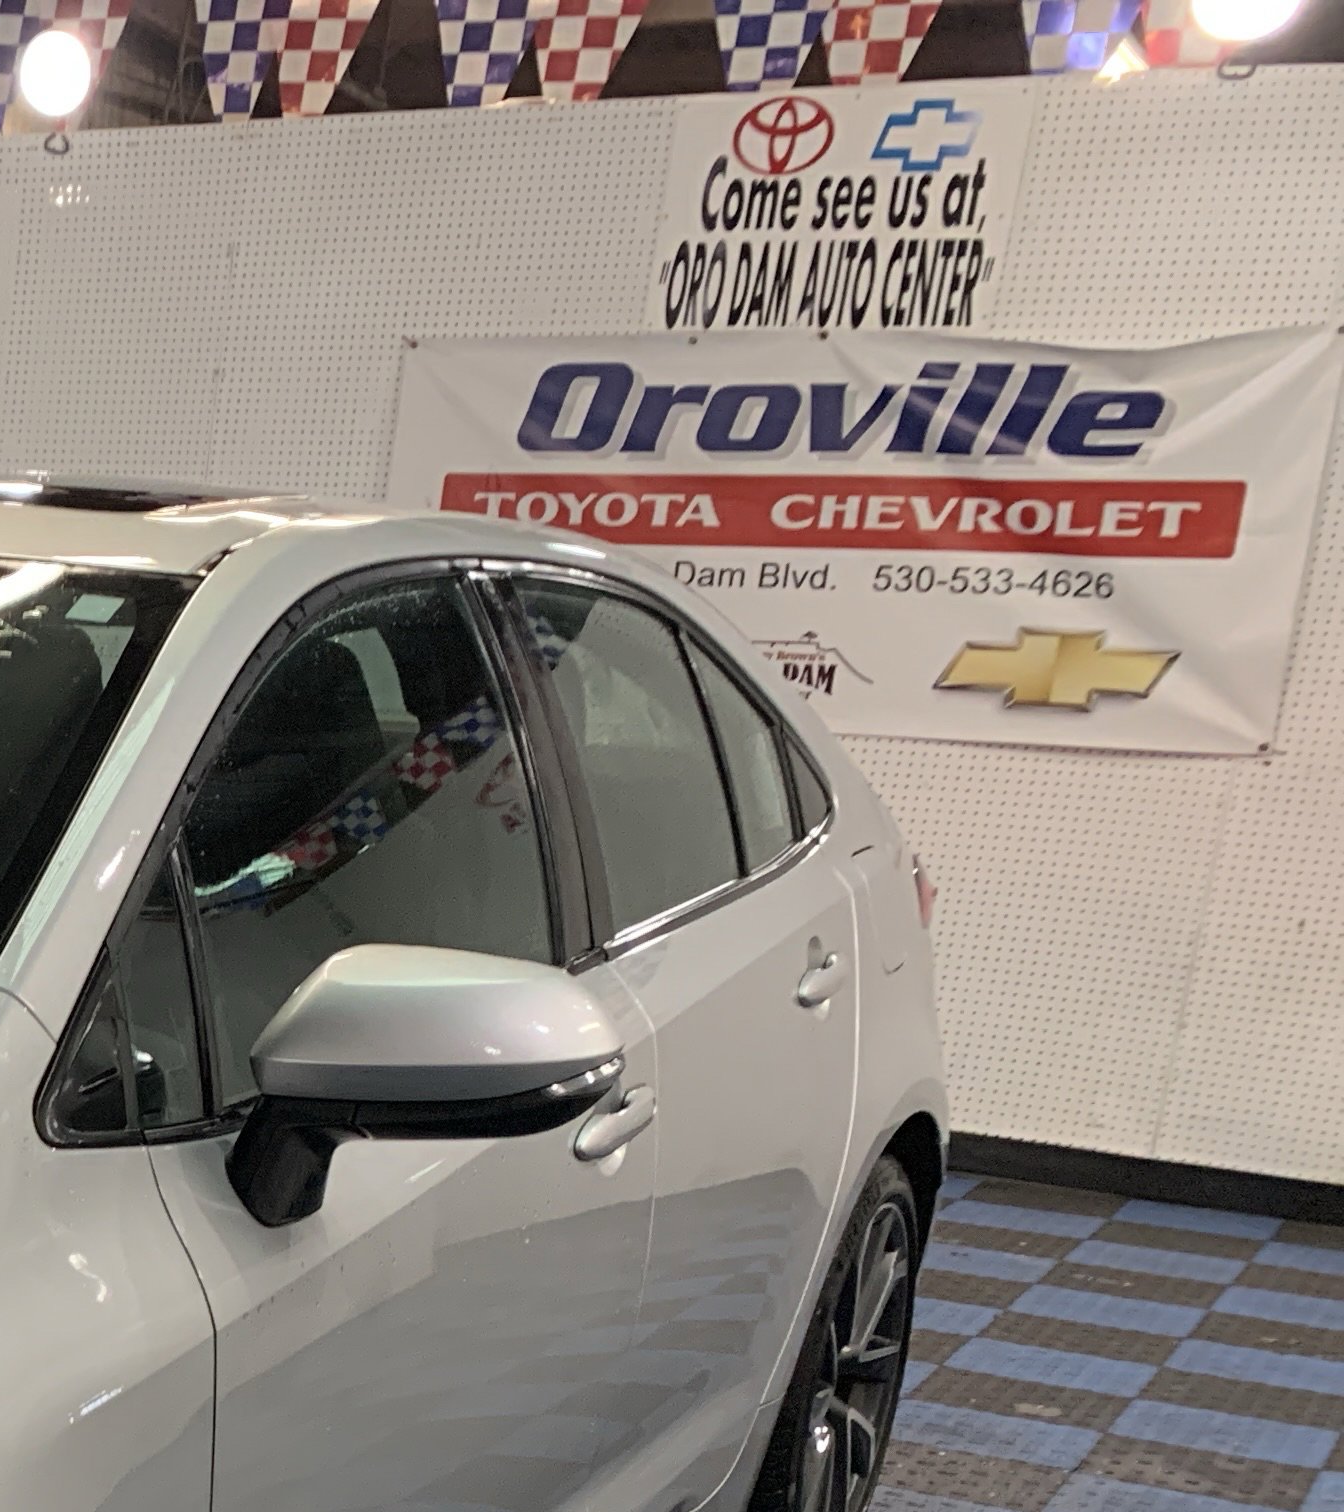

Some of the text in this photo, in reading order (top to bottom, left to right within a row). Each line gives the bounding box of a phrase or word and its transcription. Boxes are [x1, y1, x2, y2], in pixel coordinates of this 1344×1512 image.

[701, 154, 988, 234] Come see us at,
[727, 240, 799, 328] DAM
[796, 237, 878, 330] AUTO
[517, 360, 1168, 460] Oroville
[474, 491, 1202, 539] TOYOTA CHEVROLET
[674, 560, 1116, 600] Dam Blvd. 530-533-4626
[783, 662, 839, 696] DAM
